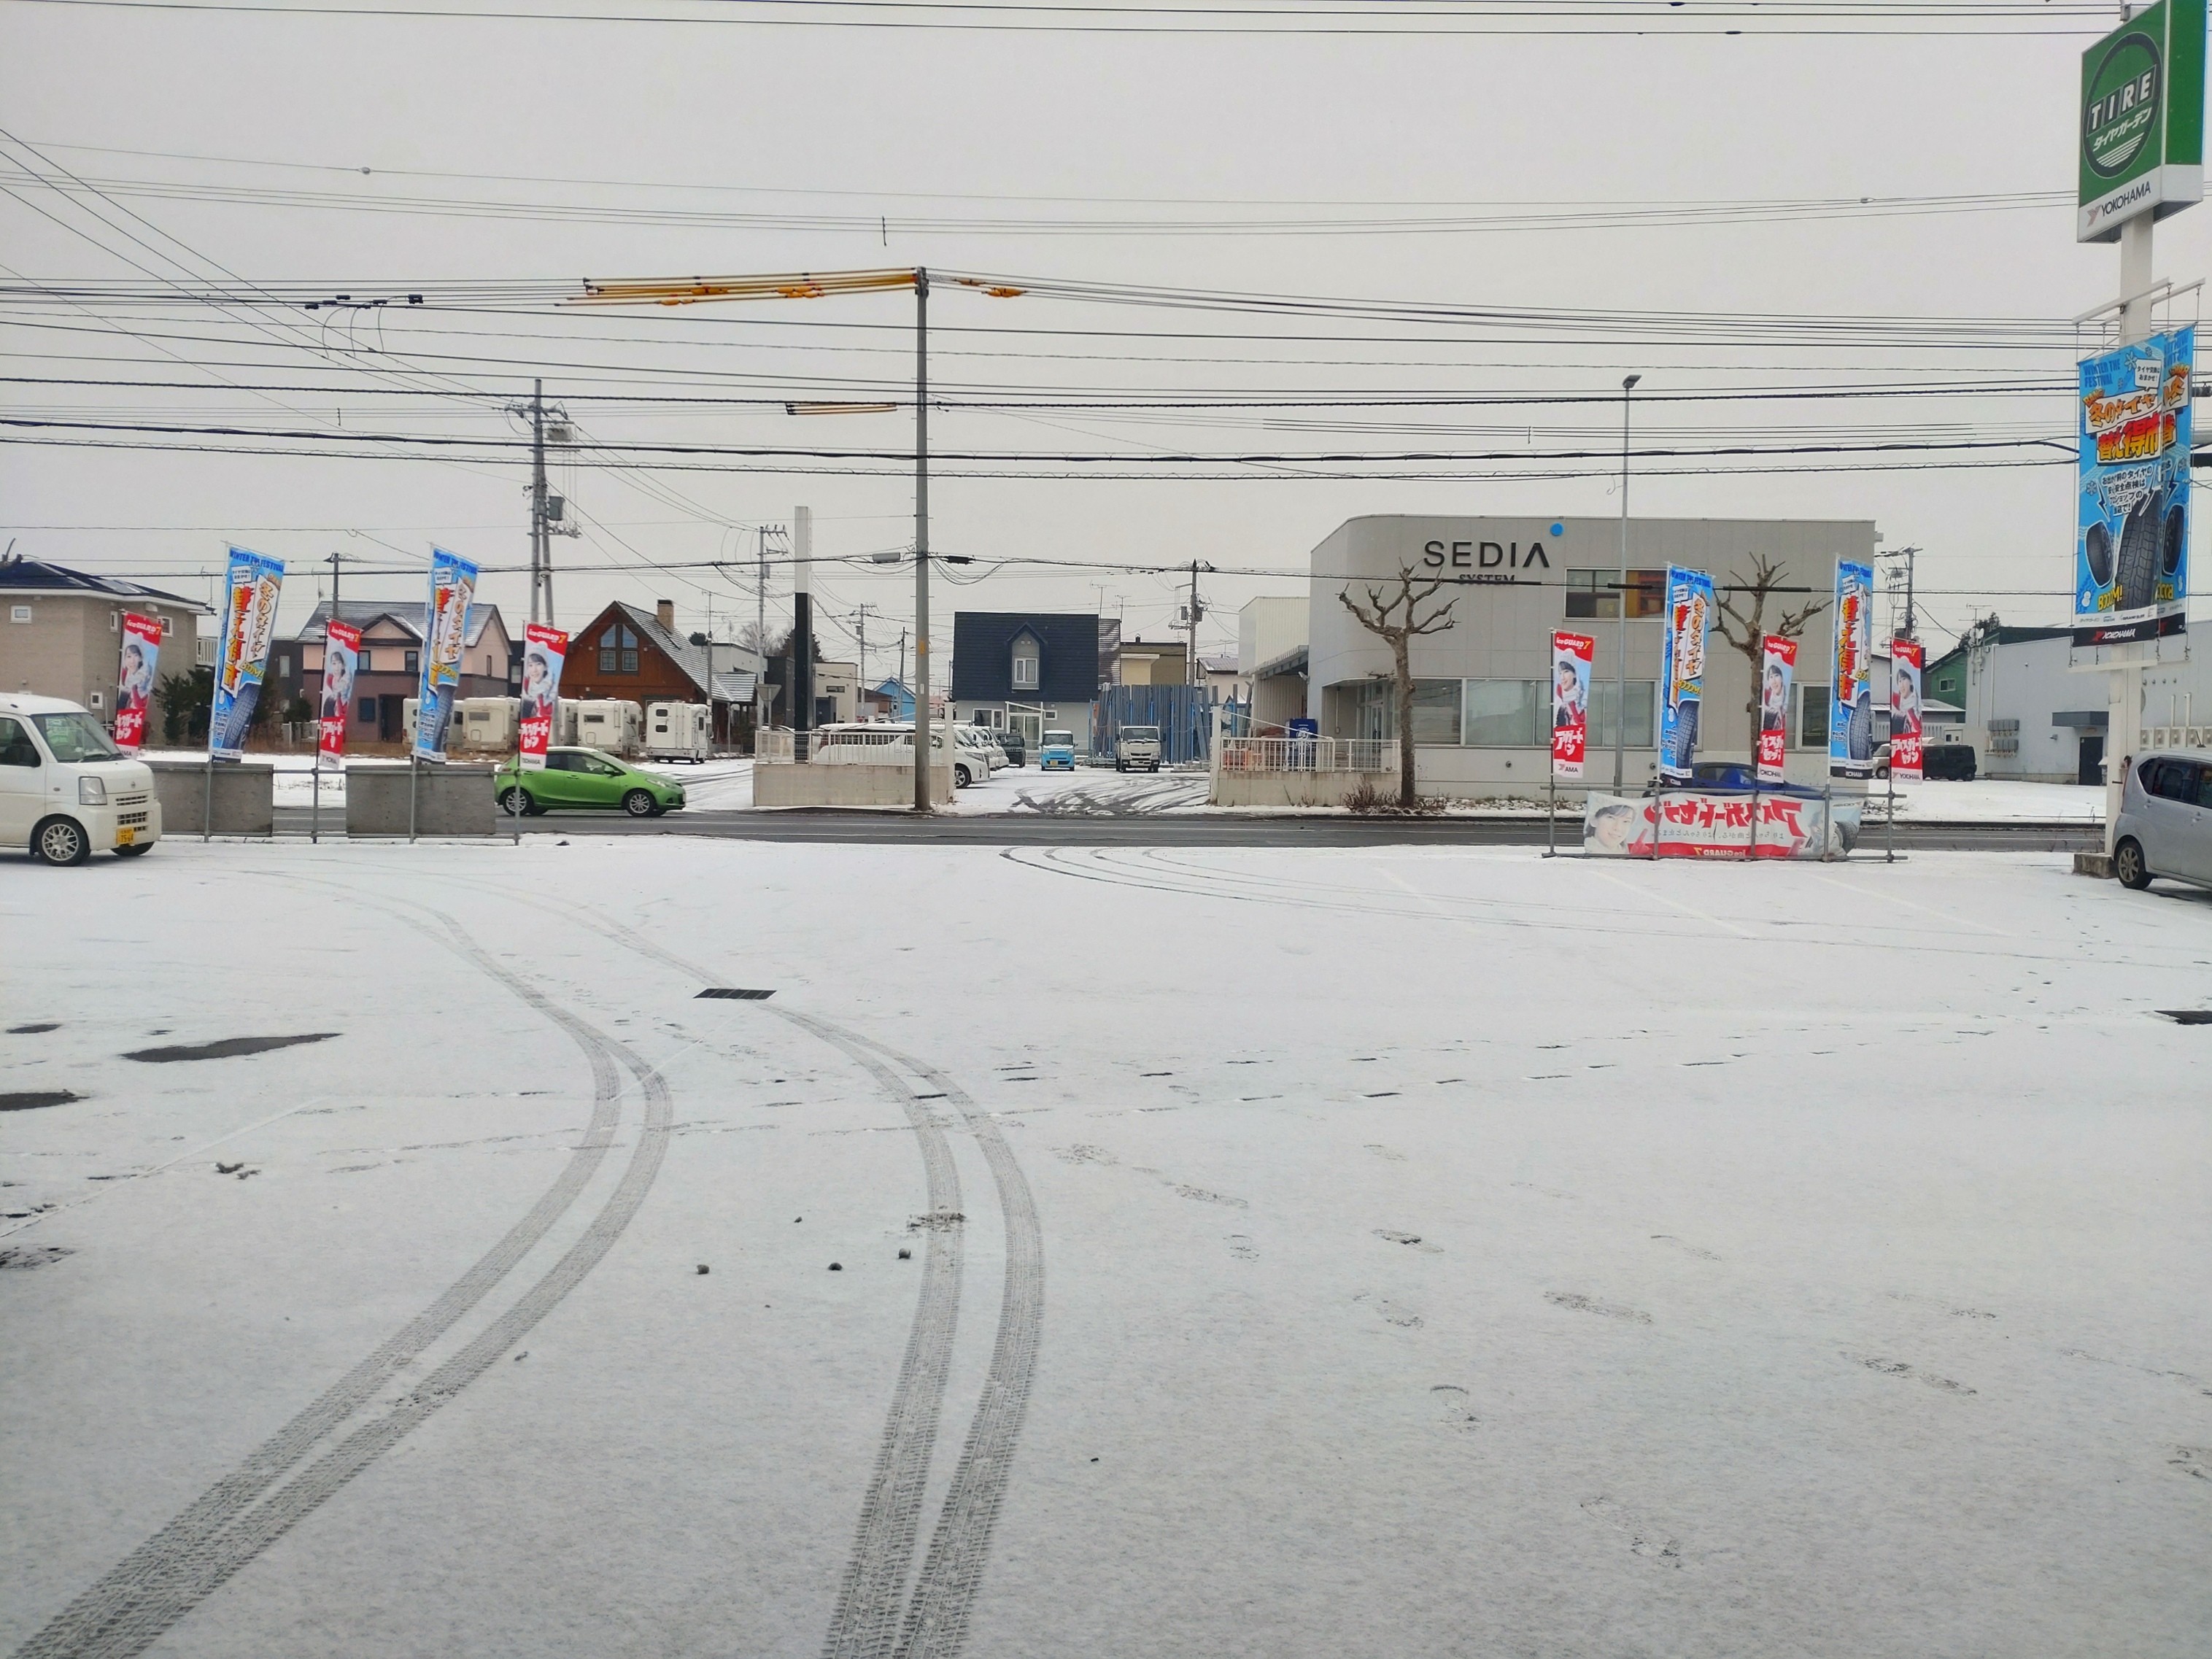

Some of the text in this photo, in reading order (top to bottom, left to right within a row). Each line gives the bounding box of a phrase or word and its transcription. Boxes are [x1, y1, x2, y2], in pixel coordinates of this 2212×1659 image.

[2092, 71, 2152, 130] TIRE
[2092, 107, 2153, 152] タイヤガーデン
[2101, 181, 2151, 217] YOKOHAMA
[1423, 541, 1550, 568] SEDIA
[251, 581, 274, 658] 冬のタイヤ
